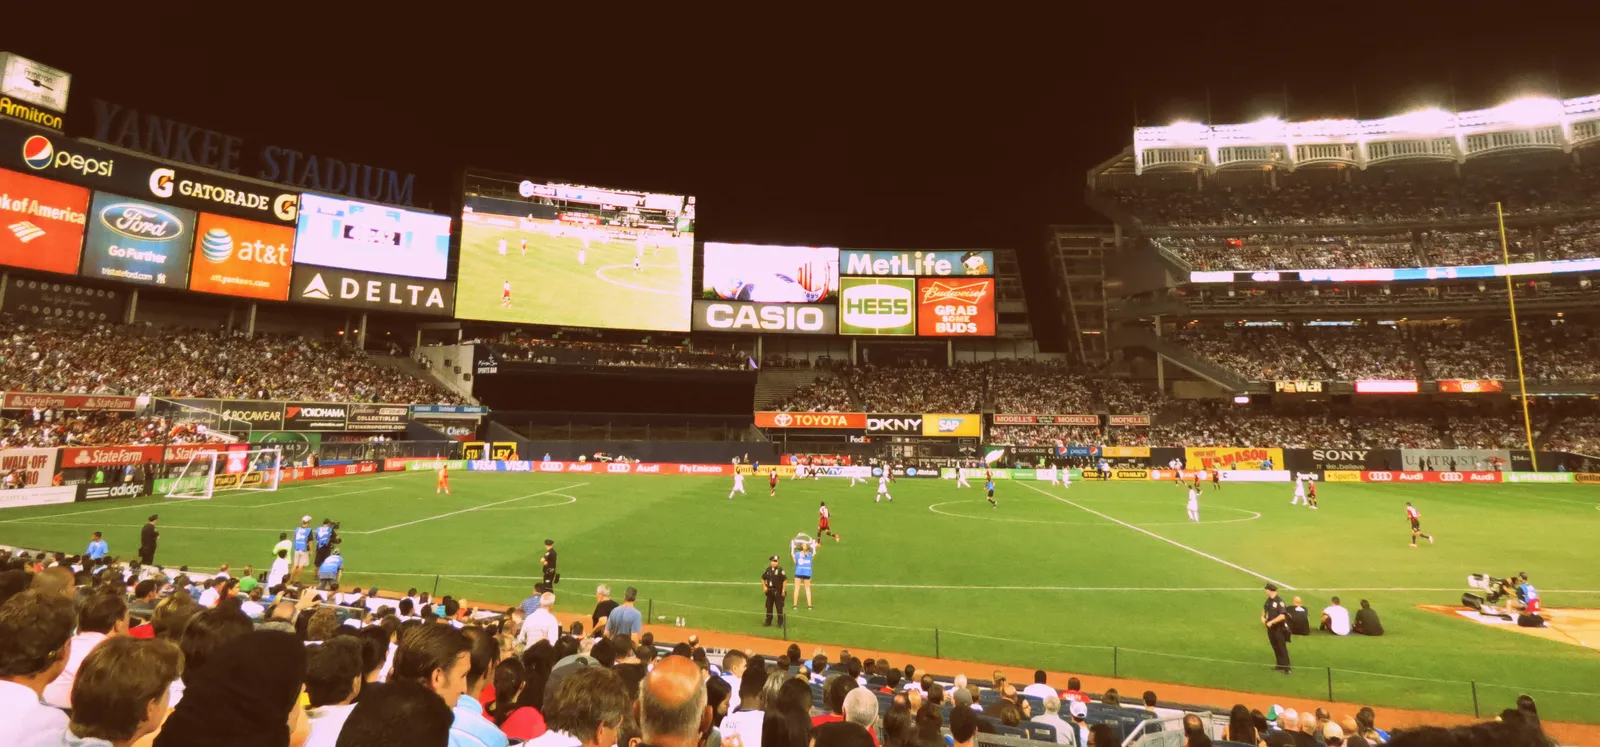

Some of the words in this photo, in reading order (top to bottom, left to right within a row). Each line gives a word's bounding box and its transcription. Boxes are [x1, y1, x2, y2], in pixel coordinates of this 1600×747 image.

[0, 97, 63, 129] Armitron
[94, 99, 243, 173] YANKEE
[262, 145, 416, 206] STADIUM
[55, 151, 114, 178] pepsi
[179, 179, 270, 211] GATORADE
[12, 197, 28, 214] of
[28, 200, 86, 225] America
[116, 207, 169, 236] Ford
[108, 245, 125, 257] Go
[126, 248, 167, 264] Further
[238, 240, 289, 266] at&t
[847, 251, 952, 275] MetLife
[340, 277, 445, 308] DELTA
[922, 287, 987, 298] Budweiser
[847, 298, 908, 316] HESS
[935, 305, 978, 316] GRAB
[706, 304, 824, 330] CASIO
[942, 315, 970, 323] SOME
[935, 323, 978, 333] BUDS
[231, 410, 281, 421] ROCAWEAR
[300, 407, 346, 417] YOKOHAMA
[794, 414, 847, 426] TOYOTA
[867, 418, 922, 431] DKNY
[938, 418, 961, 431] SAP
[850, 435, 872, 444] FedEx
[466, 449, 511, 460] STALEY
[1312, 450, 1368, 460] SONY
[361, 464, 373, 472] Audi
[471, 460, 497, 470] VISA
[504, 460, 530, 471] VISA
[569, 463, 592, 471] Audi
[636, 464, 660, 472] Audi
[679, 465, 692, 473] Fly
[1399, 472, 1423, 480] Audi
